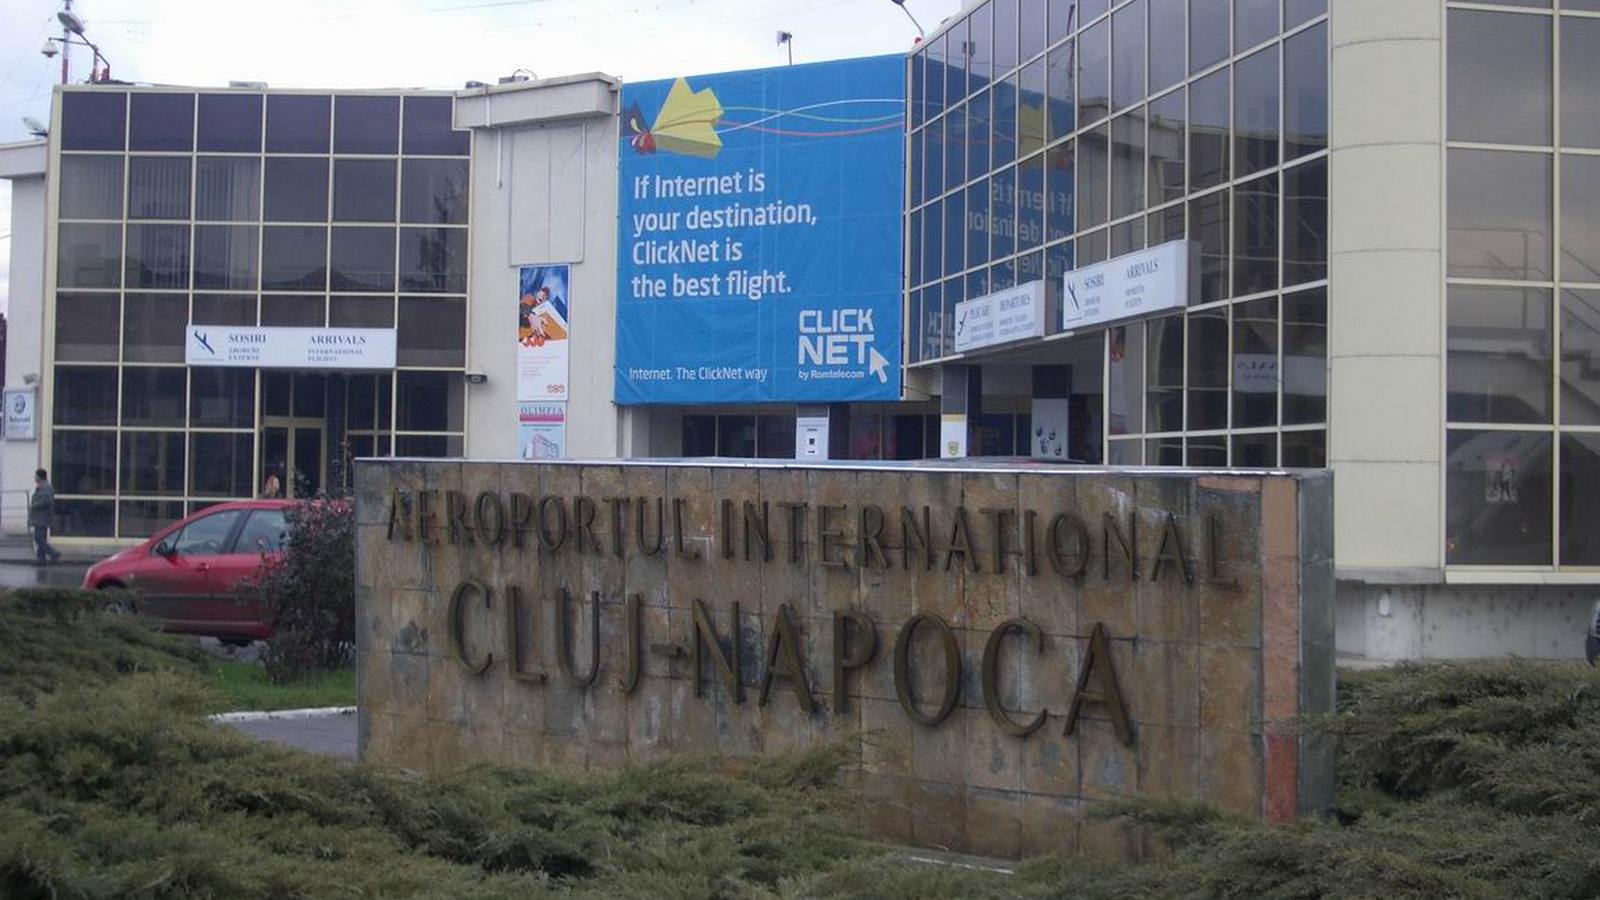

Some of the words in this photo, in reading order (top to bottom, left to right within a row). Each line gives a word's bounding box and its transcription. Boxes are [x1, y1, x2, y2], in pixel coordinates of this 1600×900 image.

[633, 175, 650, 199] If
[655, 171, 743, 198] Internet
[748, 168, 766, 193] is
[633, 211, 681, 238] your
[686, 200, 817, 230] destination,
[632, 239, 720, 265] ClickNet
[725, 237, 743, 262] is
[631, 274, 667, 298] the
[673, 273, 720, 297] best
[726, 269, 792, 300] flight.
[799, 308, 875, 333] CLICK
[228, 334, 266, 344] SOSIRI
[310, 335, 367, 345] ARRIVALS
[798, 334, 875, 365] NET
[629, 367, 672, 380] Internet.
[675, 367, 696, 380] The
[698, 366, 742, 380] ClickNet
[744, 368, 768, 382] way
[798, 370, 809, 381] by
[810, 369, 864, 379] Romtelecom
[520, 406, 565, 416] OLIMPIA
[387, 487, 700, 560] AEROPORTUL
[720, 498, 1240, 588] INTERNATIONAL
[447, 579, 1137, 748] CLUJ-NAPOCA
